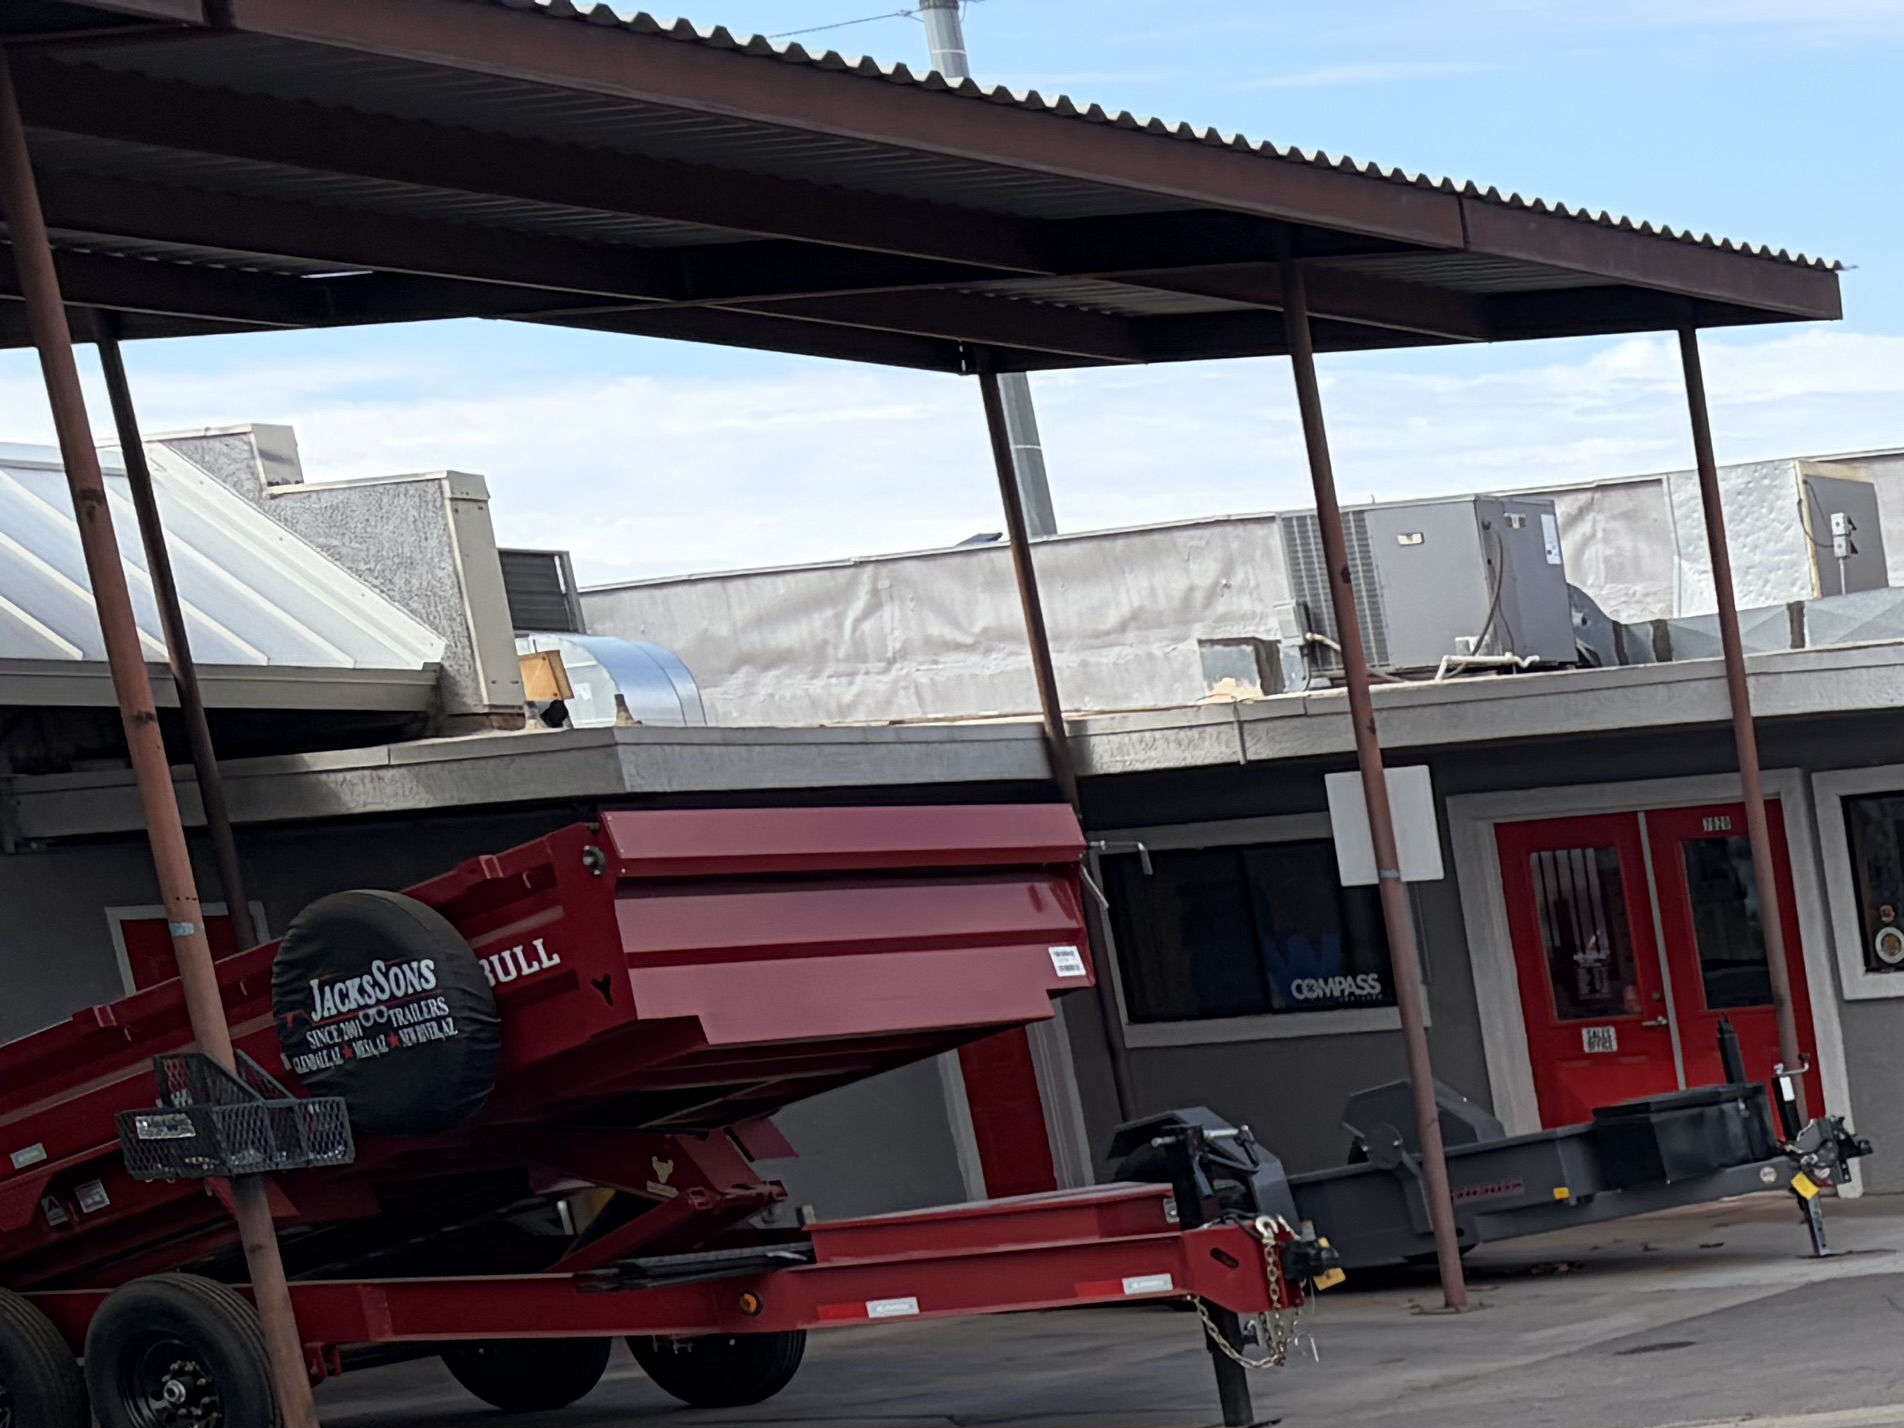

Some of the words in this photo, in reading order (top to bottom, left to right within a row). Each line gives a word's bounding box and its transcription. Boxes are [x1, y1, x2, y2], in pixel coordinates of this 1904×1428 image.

[1291, 973, 1382, 1000] COMPASS
[306, 1027, 342, 1050] SINCE
[388, 996, 450, 1028] TRAILERS
